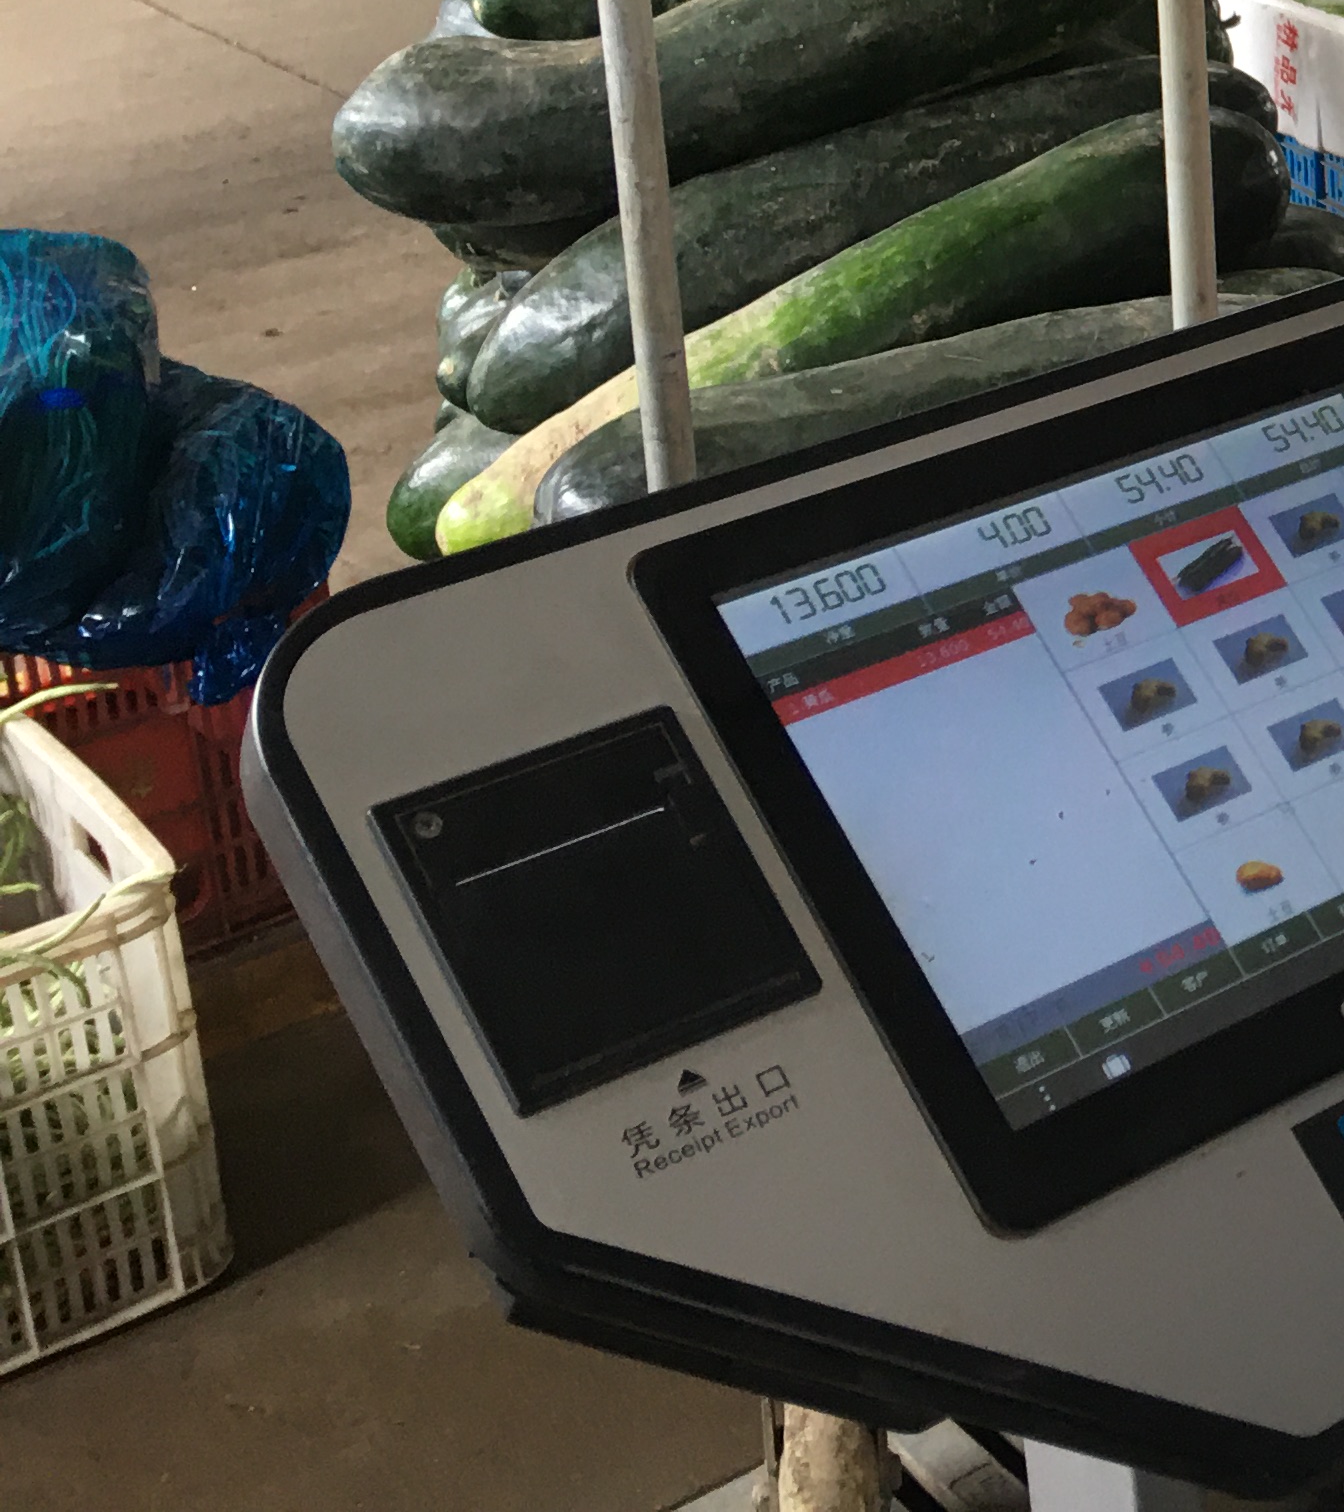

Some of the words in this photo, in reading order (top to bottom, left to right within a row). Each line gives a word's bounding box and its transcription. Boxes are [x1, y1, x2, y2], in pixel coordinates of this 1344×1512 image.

[769, 562, 888, 625] 13.600
[977, 505, 1053, 549] 4.00
[1113, 453, 1205, 505] 54.40
[621, 1064, 791, 1159] 凭条出口
[633, 1127, 724, 1179] Receipt
[724, 1093, 799, 1139] Export
